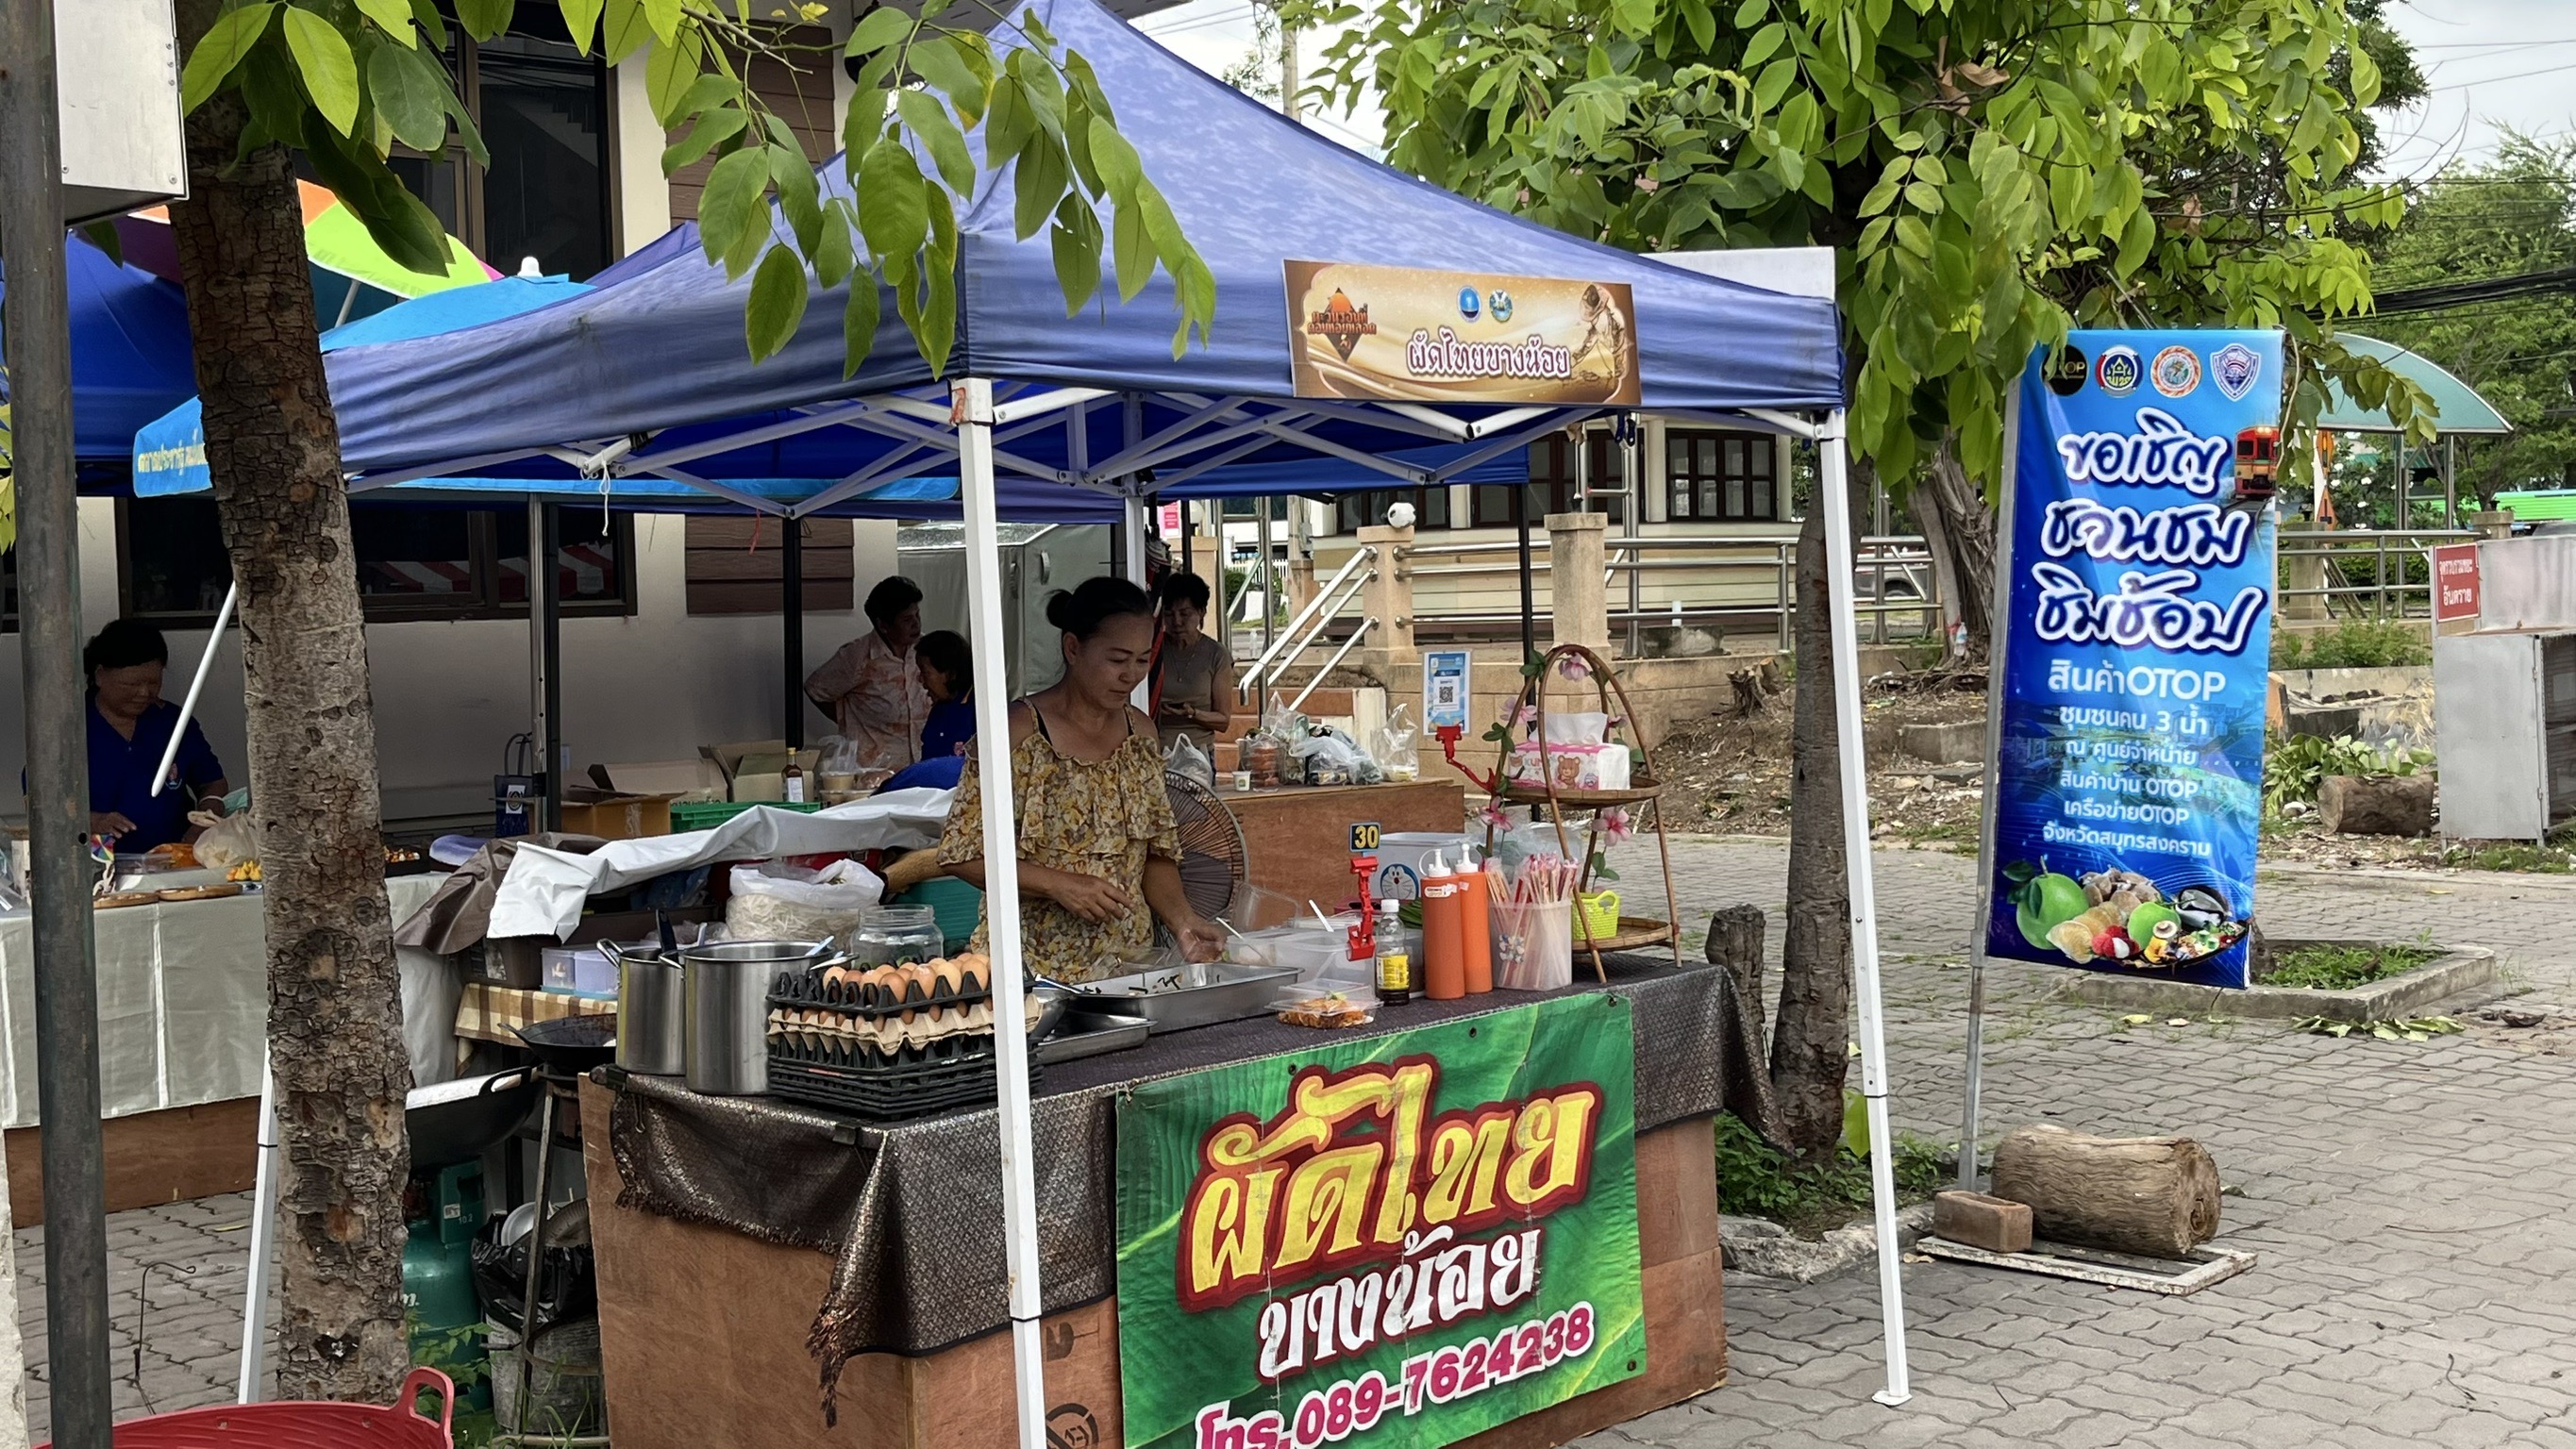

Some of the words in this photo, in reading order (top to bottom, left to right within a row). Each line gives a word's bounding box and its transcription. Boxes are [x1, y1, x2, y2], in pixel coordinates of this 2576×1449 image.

[1409, 328, 1570, 378] ผัดไทยบางน้อย
[2058, 408, 2227, 493] ขอเชิญ
[2042, 499, 2250, 564] ชวนชม
[2032, 562, 2263, 651] ชิมช้อป
[2443, 585, 2472, 606] อันตราย
[2059, 706, 2147, 731] ชุมชนคน
[2155, 711, 2170, 733] 3
[2180, 704, 2209, 736] น้ำ
[2066, 740, 2085, 757] ณ
[2092, 733, 2200, 766] ศูนย์จำหน่าย
[2059, 770, 2142, 794] สินค้าบ้าน
[2145, 778, 2200, 800] OTOP
[1355, 825, 1380, 848] 30
[2043, 822, 2212, 857] จังหวัดสมุทรสงคราม
[1186, 1060, 1597, 1296] ผัดไทย
[1258, 1225, 1541, 1378] บางน้อย
